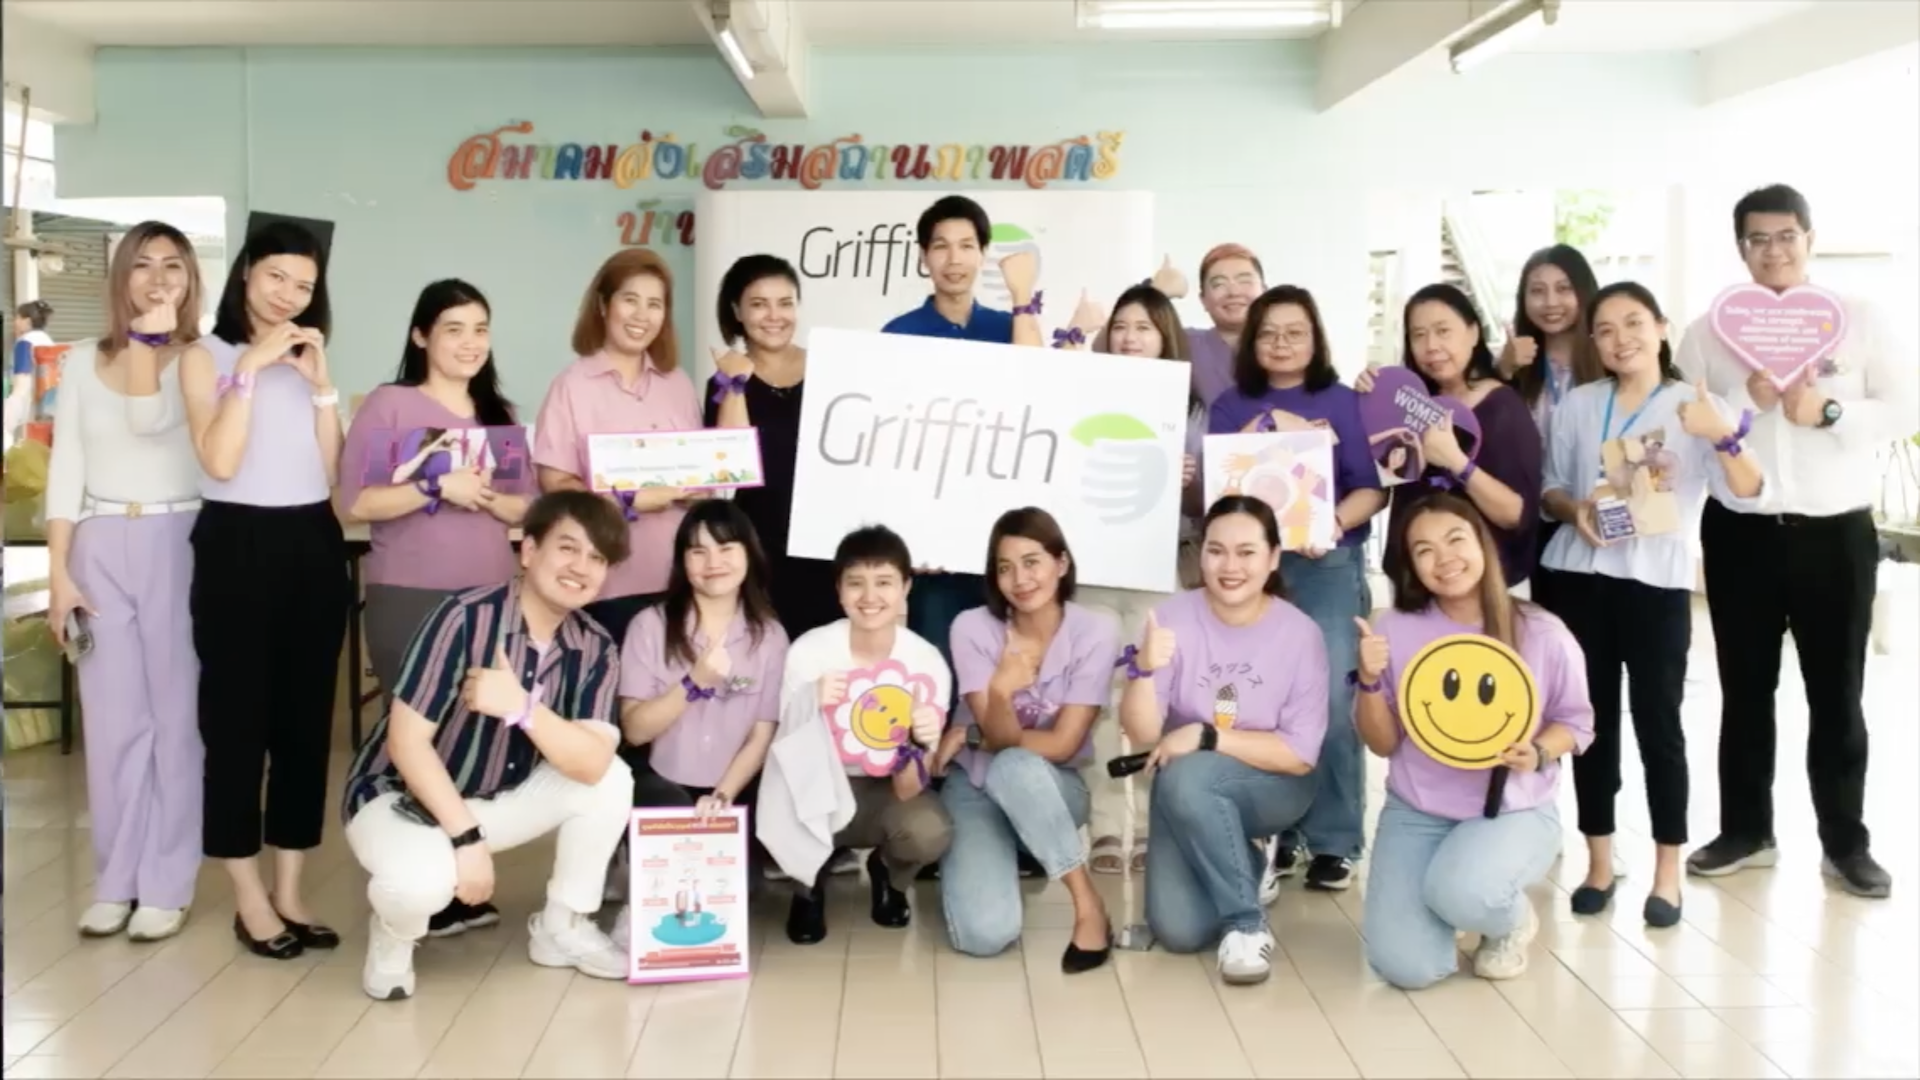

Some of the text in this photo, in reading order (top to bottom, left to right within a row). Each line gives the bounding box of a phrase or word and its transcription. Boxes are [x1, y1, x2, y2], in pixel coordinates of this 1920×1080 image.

[799, 222, 932, 297] Griffit
[818, 392, 1059, 500] Griffith
[1403, 414, 1427, 432] DAY
